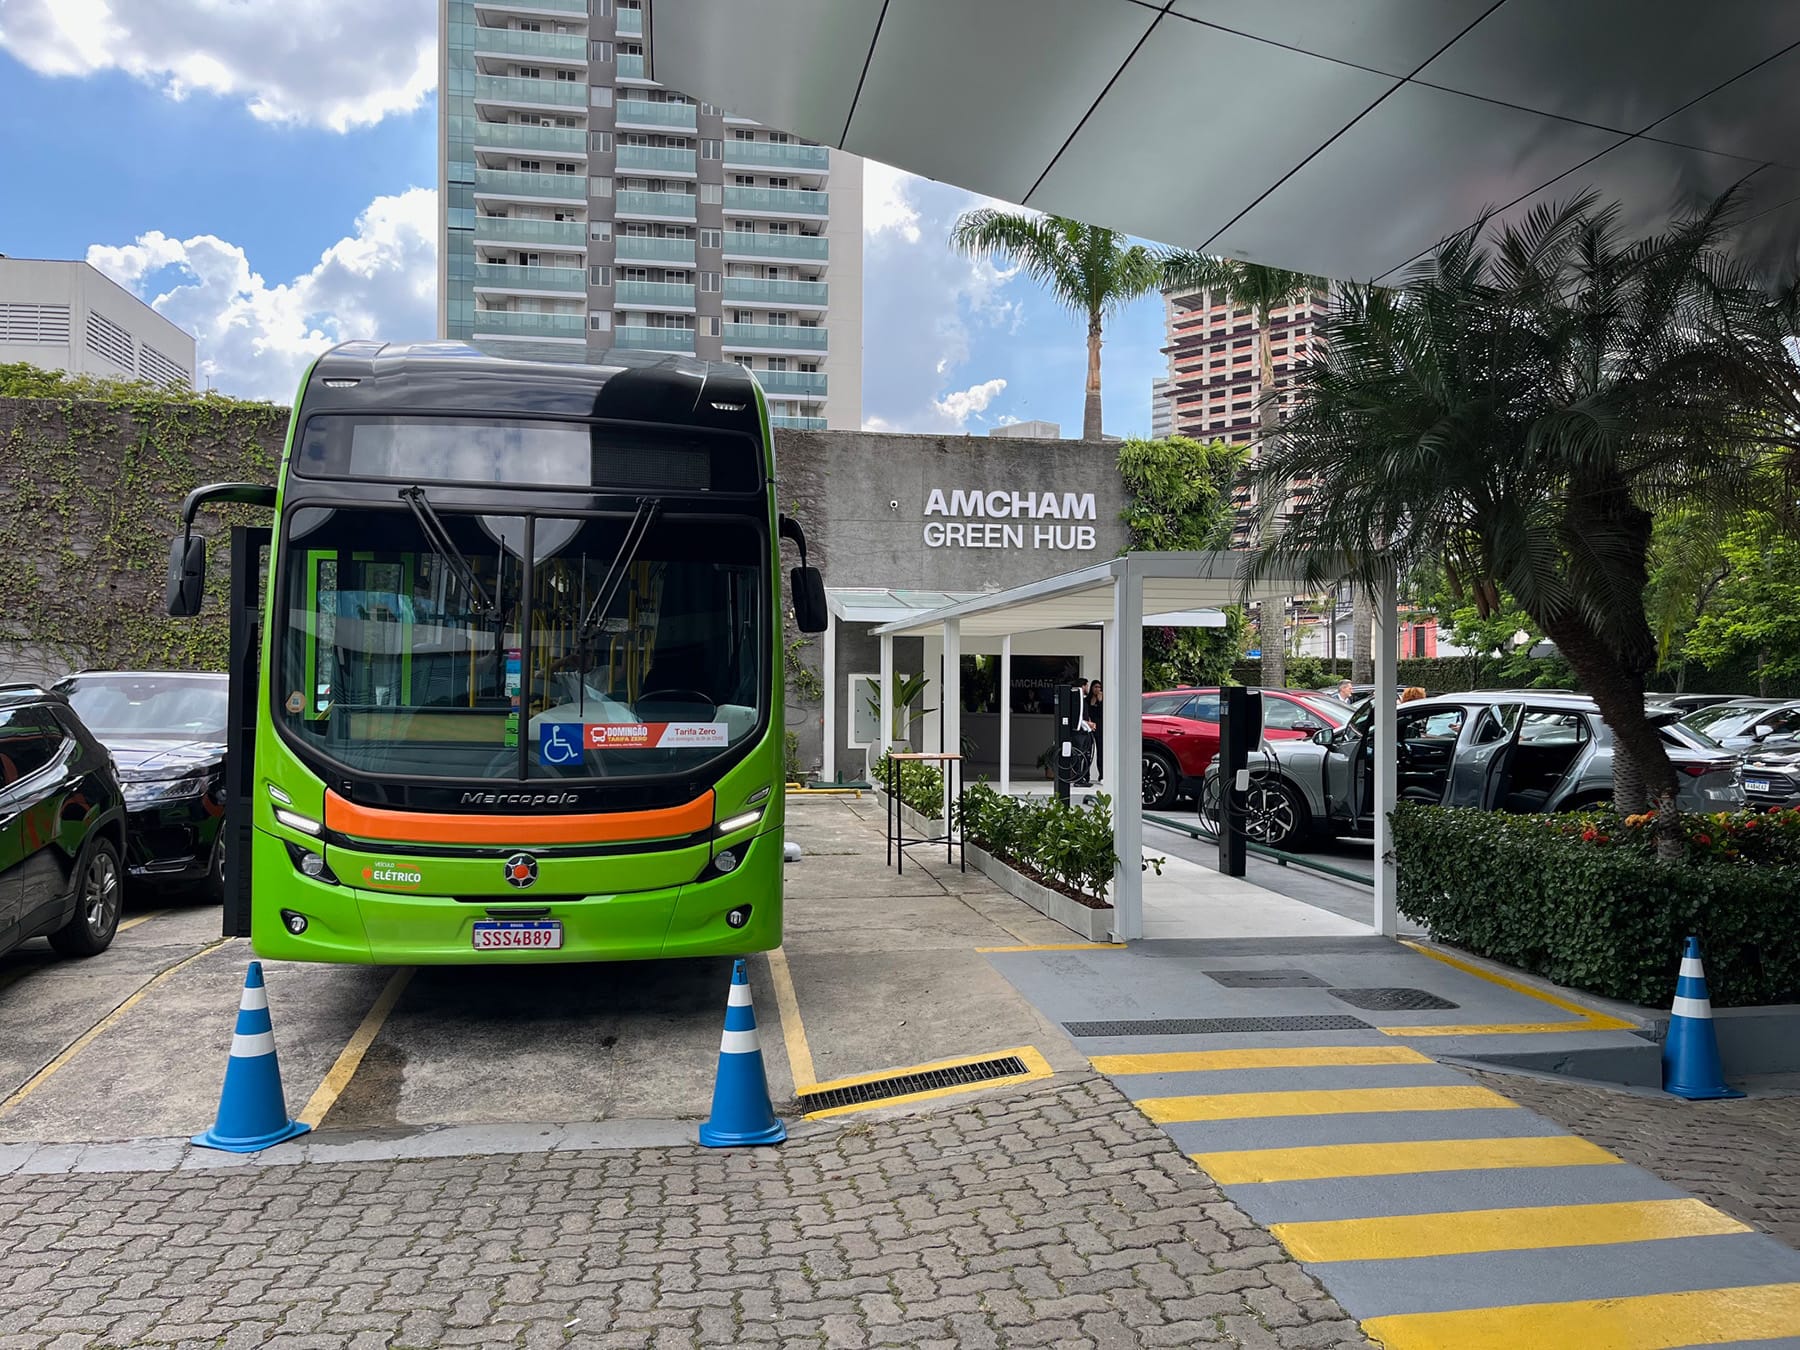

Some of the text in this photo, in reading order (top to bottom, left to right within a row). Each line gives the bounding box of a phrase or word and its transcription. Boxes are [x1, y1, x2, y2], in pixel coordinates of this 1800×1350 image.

[923, 488, 1097, 520] AMCHAM
[923, 522, 1097, 550] GREEN HUB
[607, 725, 648, 736] DOMINGÃO
[460, 792, 579, 806] Marcopolo
[373, 869, 422, 883] ELÉTRICO
[482, 931, 552, 946] SSS4B89
